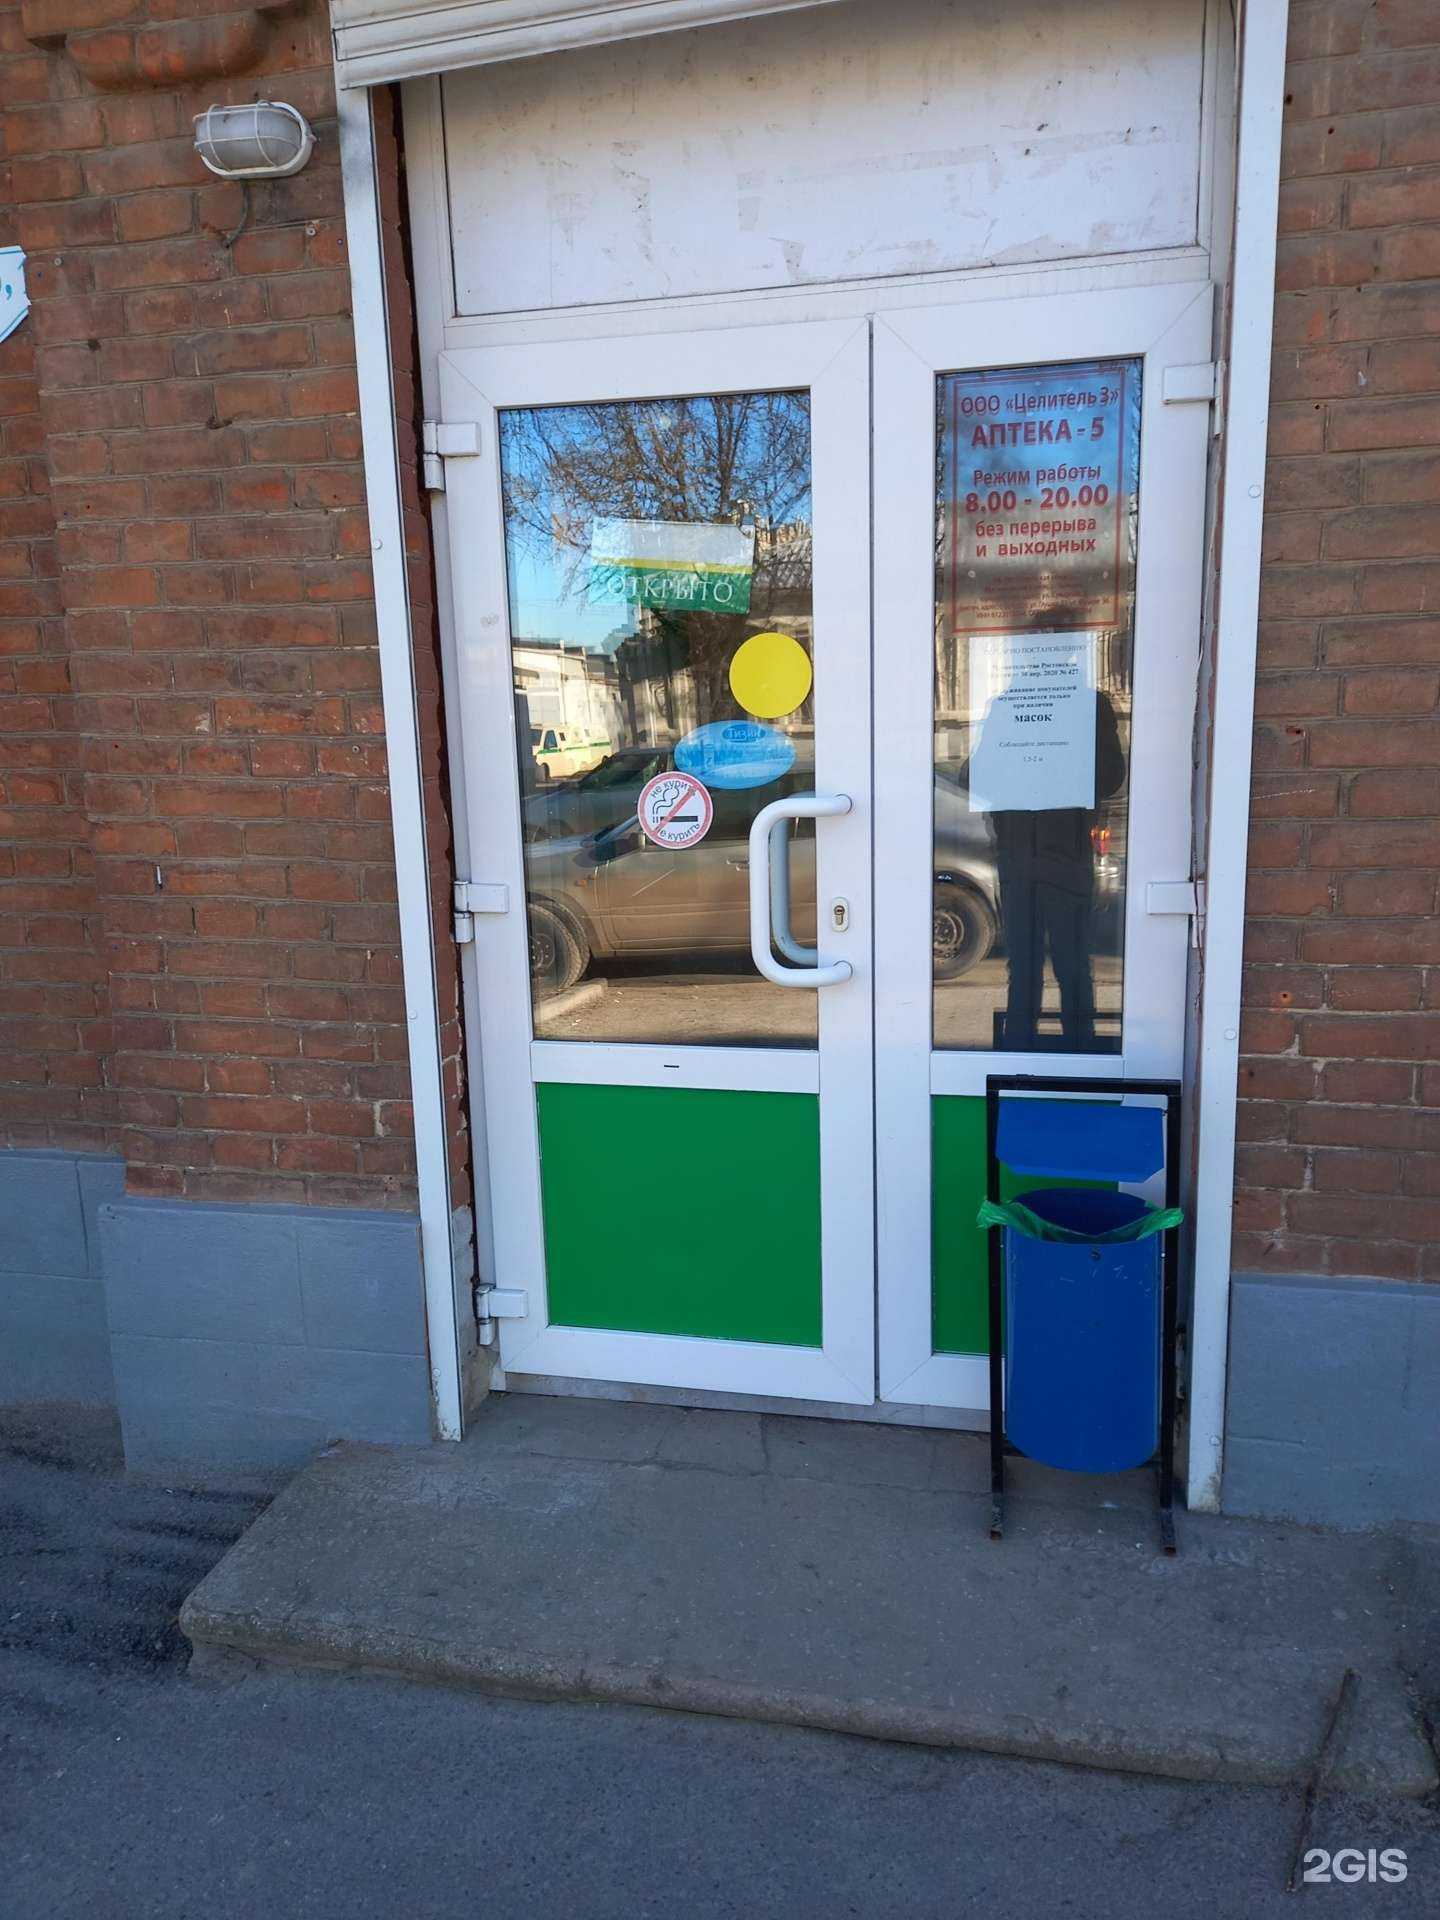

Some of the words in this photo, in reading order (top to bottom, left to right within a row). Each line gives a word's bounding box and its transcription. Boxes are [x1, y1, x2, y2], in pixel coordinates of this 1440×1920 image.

[961, 395, 1000, 414] ООО
[971, 419, 1072, 448] АПТЕКА
[1090, 416, 1105, 441] 5
[974, 470, 1030, 486] Режим
[1036, 463, 1101, 486] работы
[965, 491, 1017, 513] 8.00
[1040, 484, 1109, 512] 20.00
[975, 520, 1003, 537] без
[1010, 518, 1096, 537] перерыва
[976, 545, 987, 557] и
[998, 538, 1096, 557] выходных
[608, 575, 733, 602] ОТКРЫТО
[1015, 714, 1052, 723] масок
[651, 785, 663, 799] не
[667, 823, 700, 841] курить
